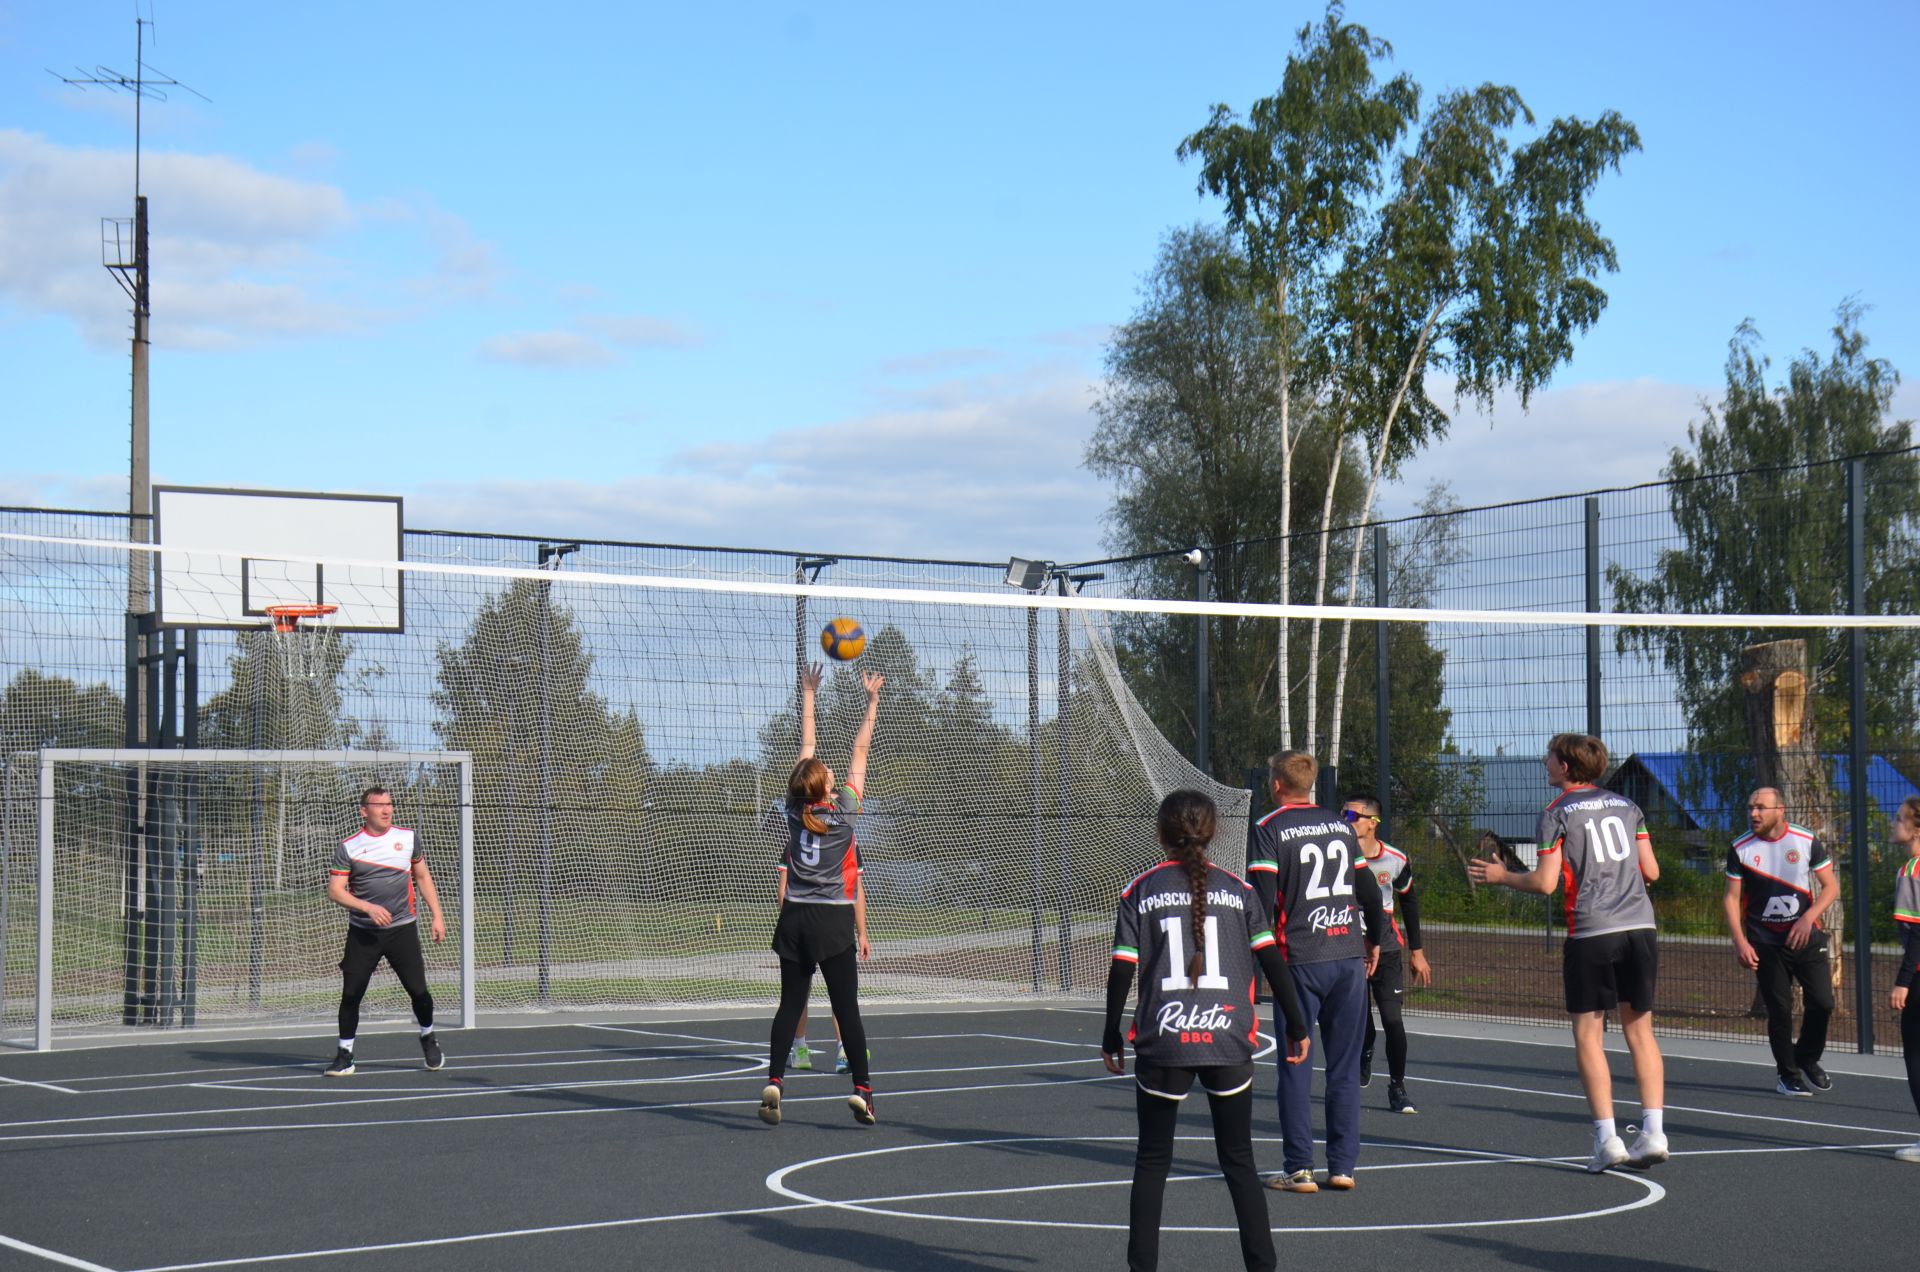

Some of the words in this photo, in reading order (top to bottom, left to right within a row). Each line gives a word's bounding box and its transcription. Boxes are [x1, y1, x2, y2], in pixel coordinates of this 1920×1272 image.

[1280, 822, 1329, 842] АГРЫЗСКИЙ
[1584, 815, 1631, 863] 10
[800, 829, 820, 867] 9
[1753, 855, 1761, 868] 9
[1300, 839, 1353, 900] 22
[1138, 892, 1193, 914] ГРЫЗСКИ
[1206, 889, 1244, 910] РАЙОН
[1326, 926, 1349, 937] BBQ
[1160, 915, 1229, 992] 11
[1156, 1001, 1232, 1036] Raketa
[1180, 1032, 1213, 1043] BBQ
